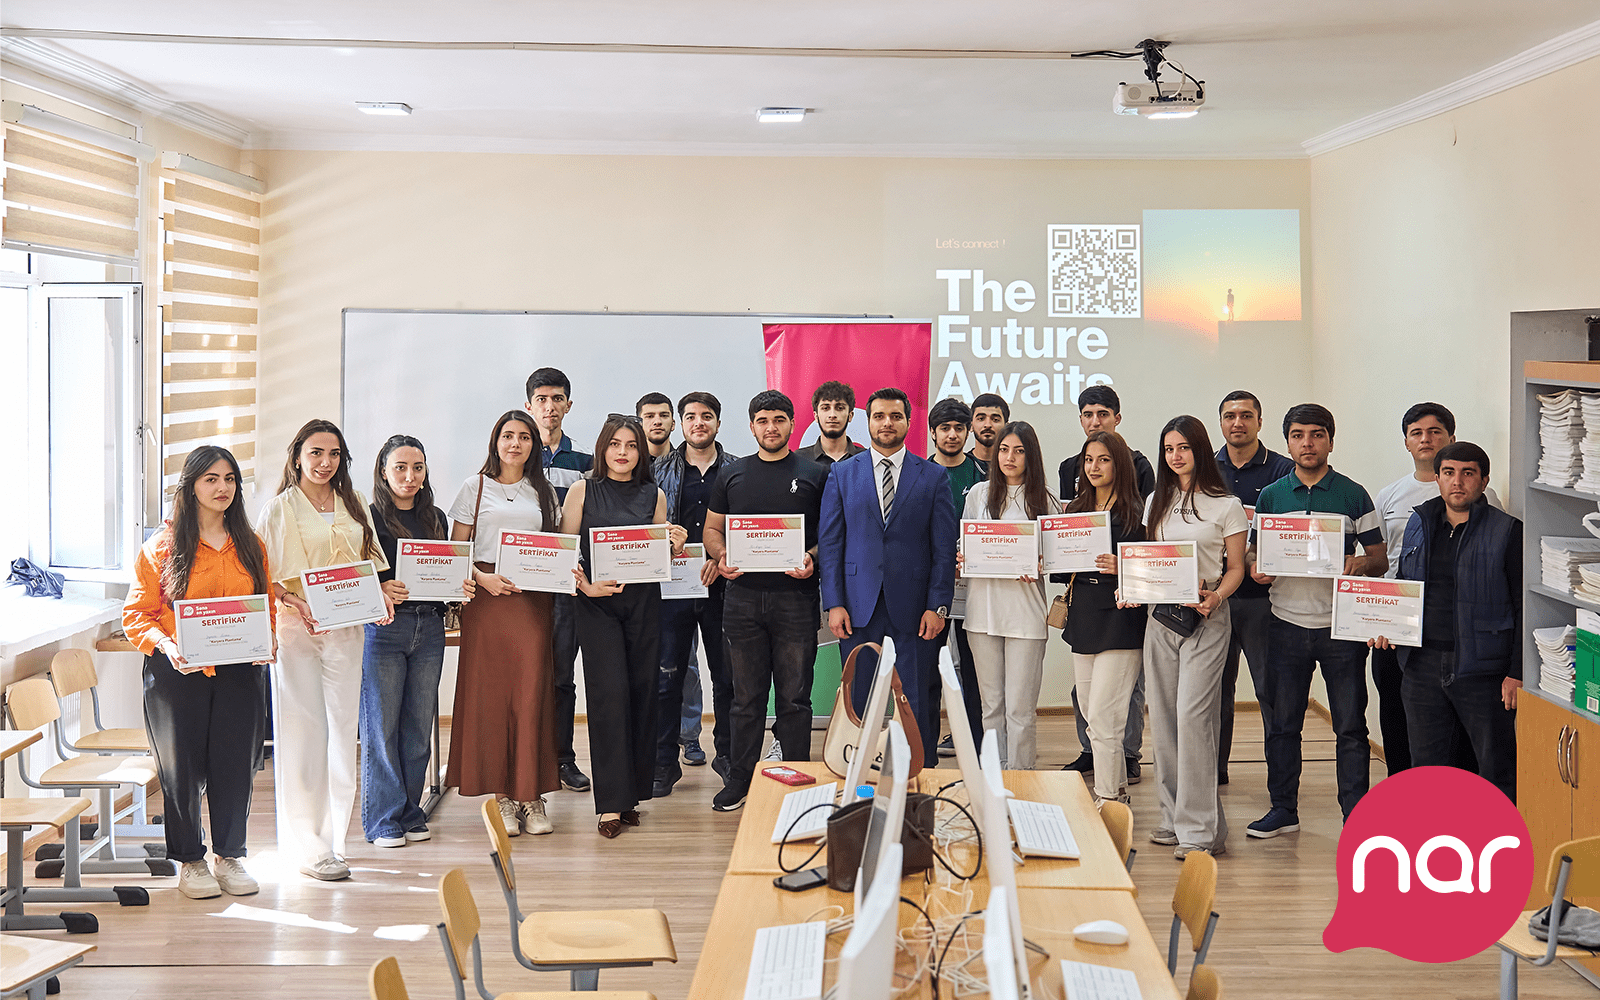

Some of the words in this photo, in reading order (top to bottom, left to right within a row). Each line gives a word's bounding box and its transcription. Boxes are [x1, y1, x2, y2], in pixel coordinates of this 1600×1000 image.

[935, 238, 960, 248] Let's
[962, 239, 1000, 249] connect
[936, 269, 1036, 312] The
[938, 314, 1109, 360] Future
[1057, 530, 1092, 538] SERTİFİKAT
[612, 542, 650, 551] SERTİFİKAT
[518, 548, 558, 557] SERTİFİKAT
[325, 580, 360, 592] SERTİFİKAT
[1356, 596, 1399, 606] SERTİFİKAT
[201, 616, 246, 626] SERTİFİKAT
